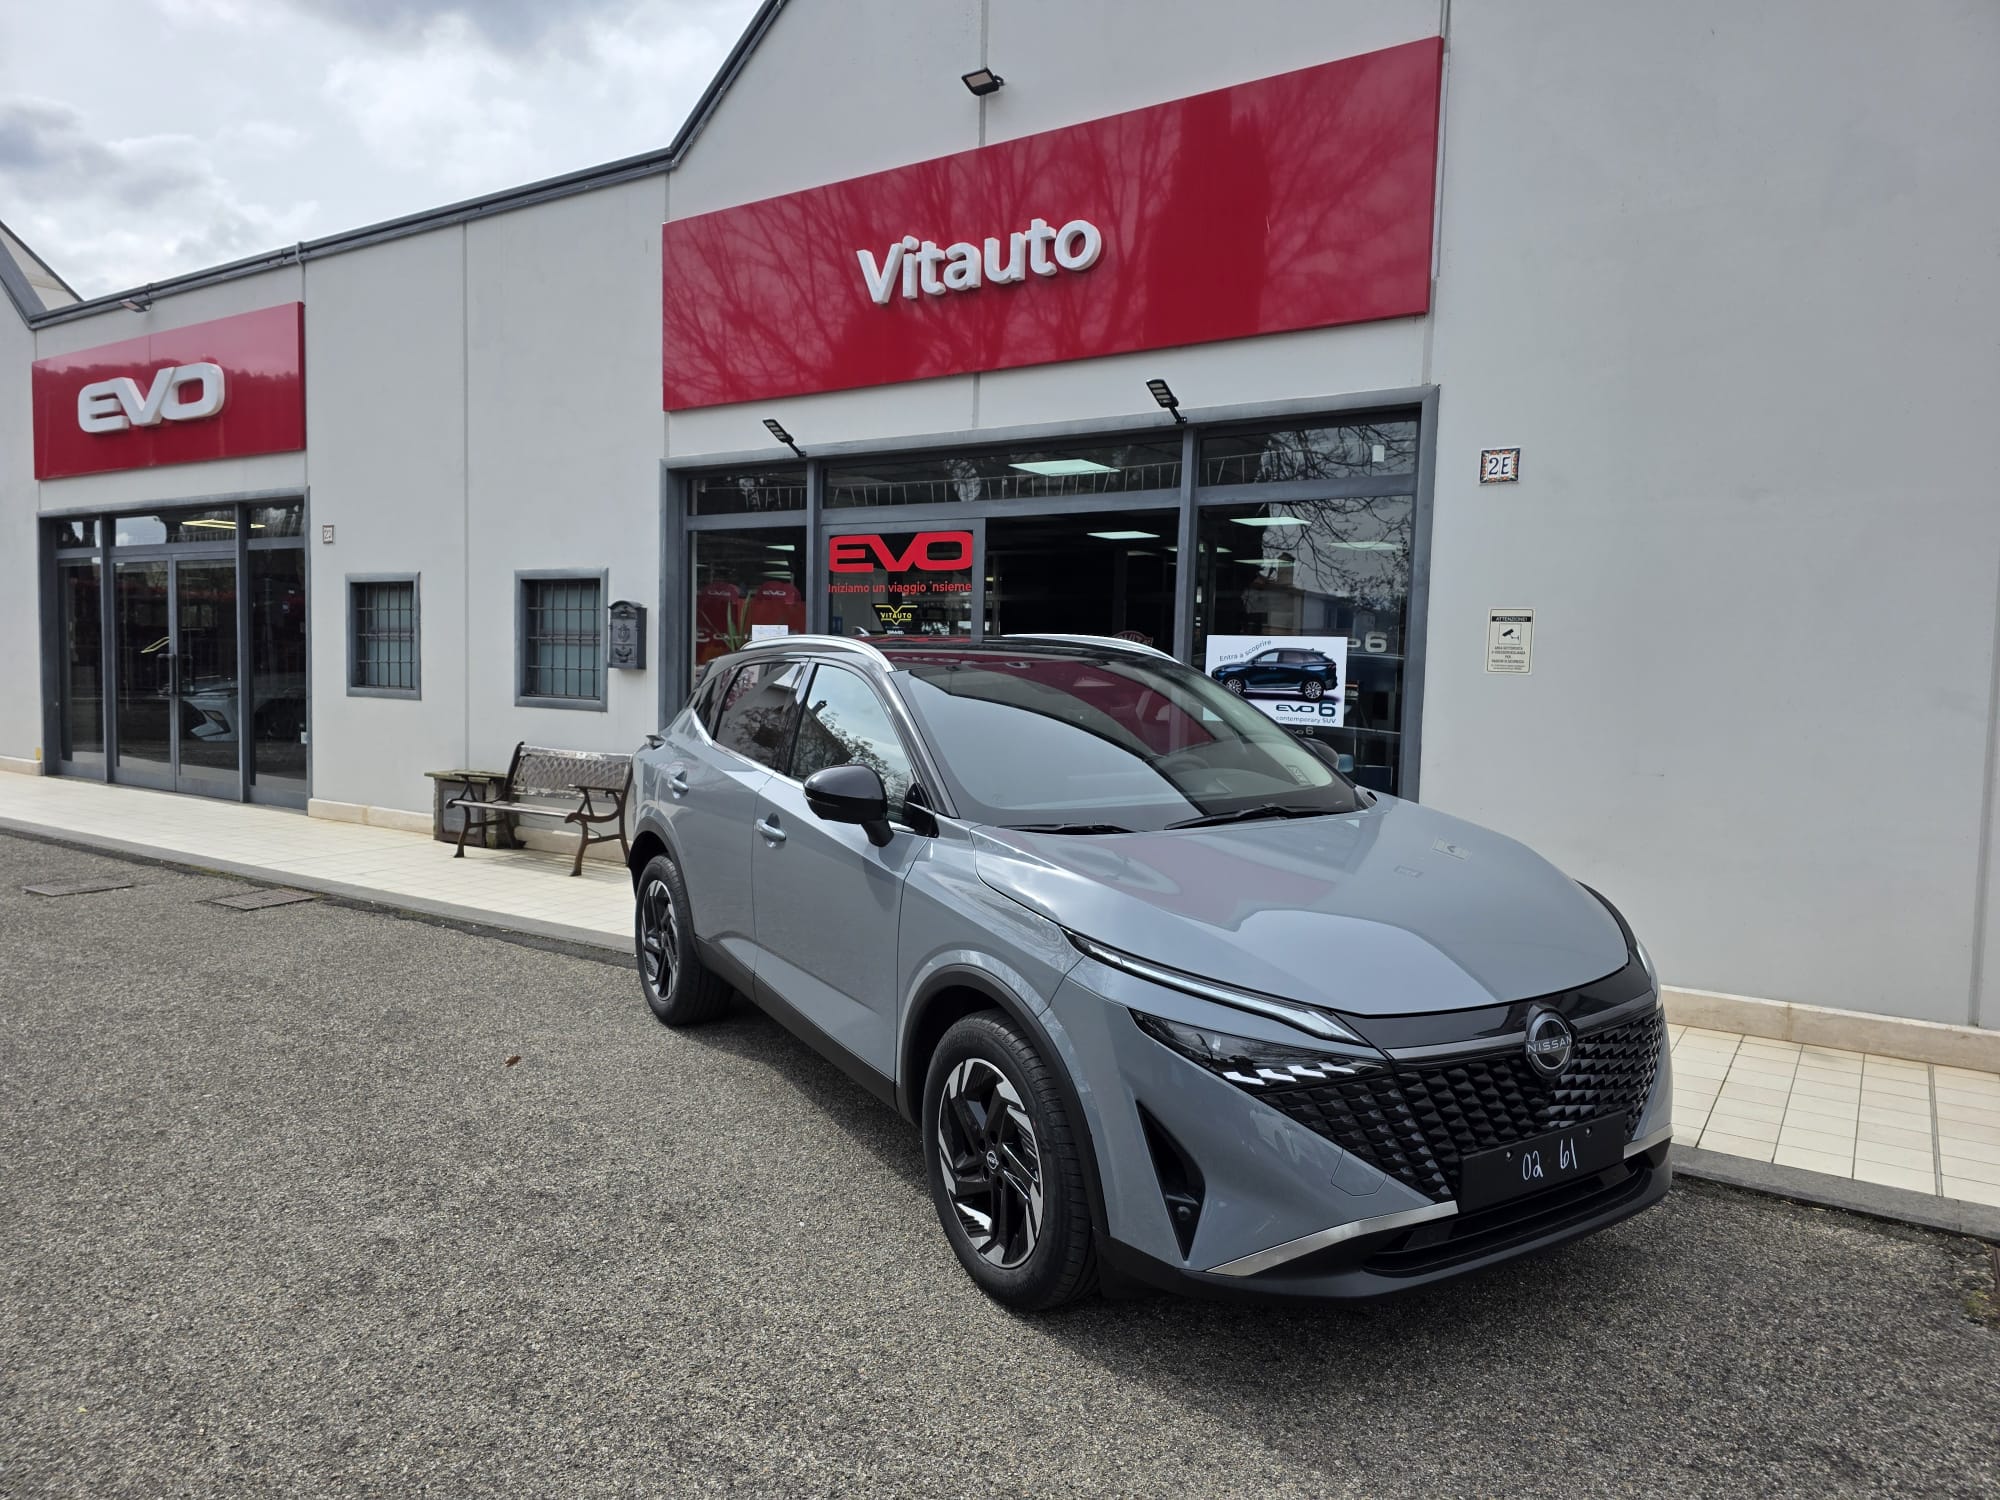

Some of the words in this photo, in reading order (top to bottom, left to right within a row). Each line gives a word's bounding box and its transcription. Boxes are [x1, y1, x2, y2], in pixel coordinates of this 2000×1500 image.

[856, 218, 1102, 304] Vitauto
[77, 362, 226, 433] EVO
[1488, 456, 1511, 475] 2E
[829, 531, 974, 573] EVO
[828, 582, 870, 593] Iniziamo
[872, 584, 886, 593] un
[888, 581, 927, 595] viaggio
[929, 581, 972, 592] nsieme
[1219, 654, 1238, 662] Entra
[1245, 640, 1272, 656] scoprire
[1364, 631, 1388, 653] 6
[1276, 704, 1315, 712] EVO
[1318, 700, 1337, 717] 6
[1527, 1036, 1571, 1053] NISSAN
